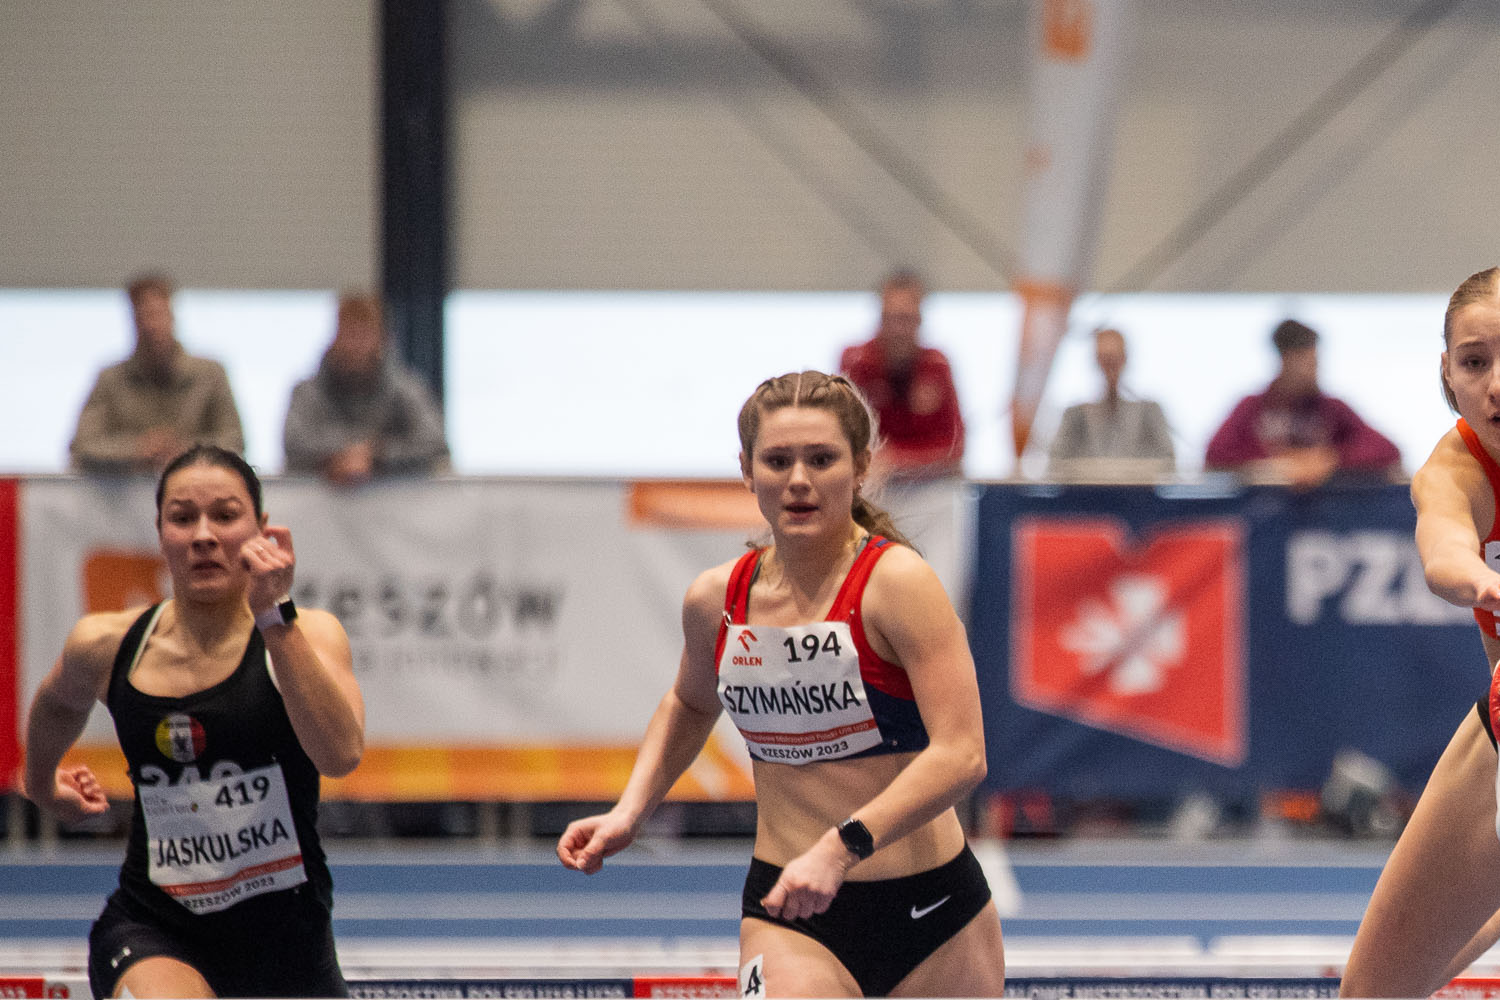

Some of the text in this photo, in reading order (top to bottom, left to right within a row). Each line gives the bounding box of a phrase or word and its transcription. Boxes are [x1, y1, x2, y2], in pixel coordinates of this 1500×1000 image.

[1285, 528, 1477, 625] PZL
[732, 656, 763, 667] ORLEN
[783, 631, 842, 663] 194
[724, 680, 862, 716] SZYMAŃSKA
[761, 740, 849, 759] RZESZÓW 2023
[214, 776, 270, 809] 419
[156, 818, 290, 869] JASKULSKA
[244, 876, 275, 892] 2023
[744, 964, 762, 997] 4
